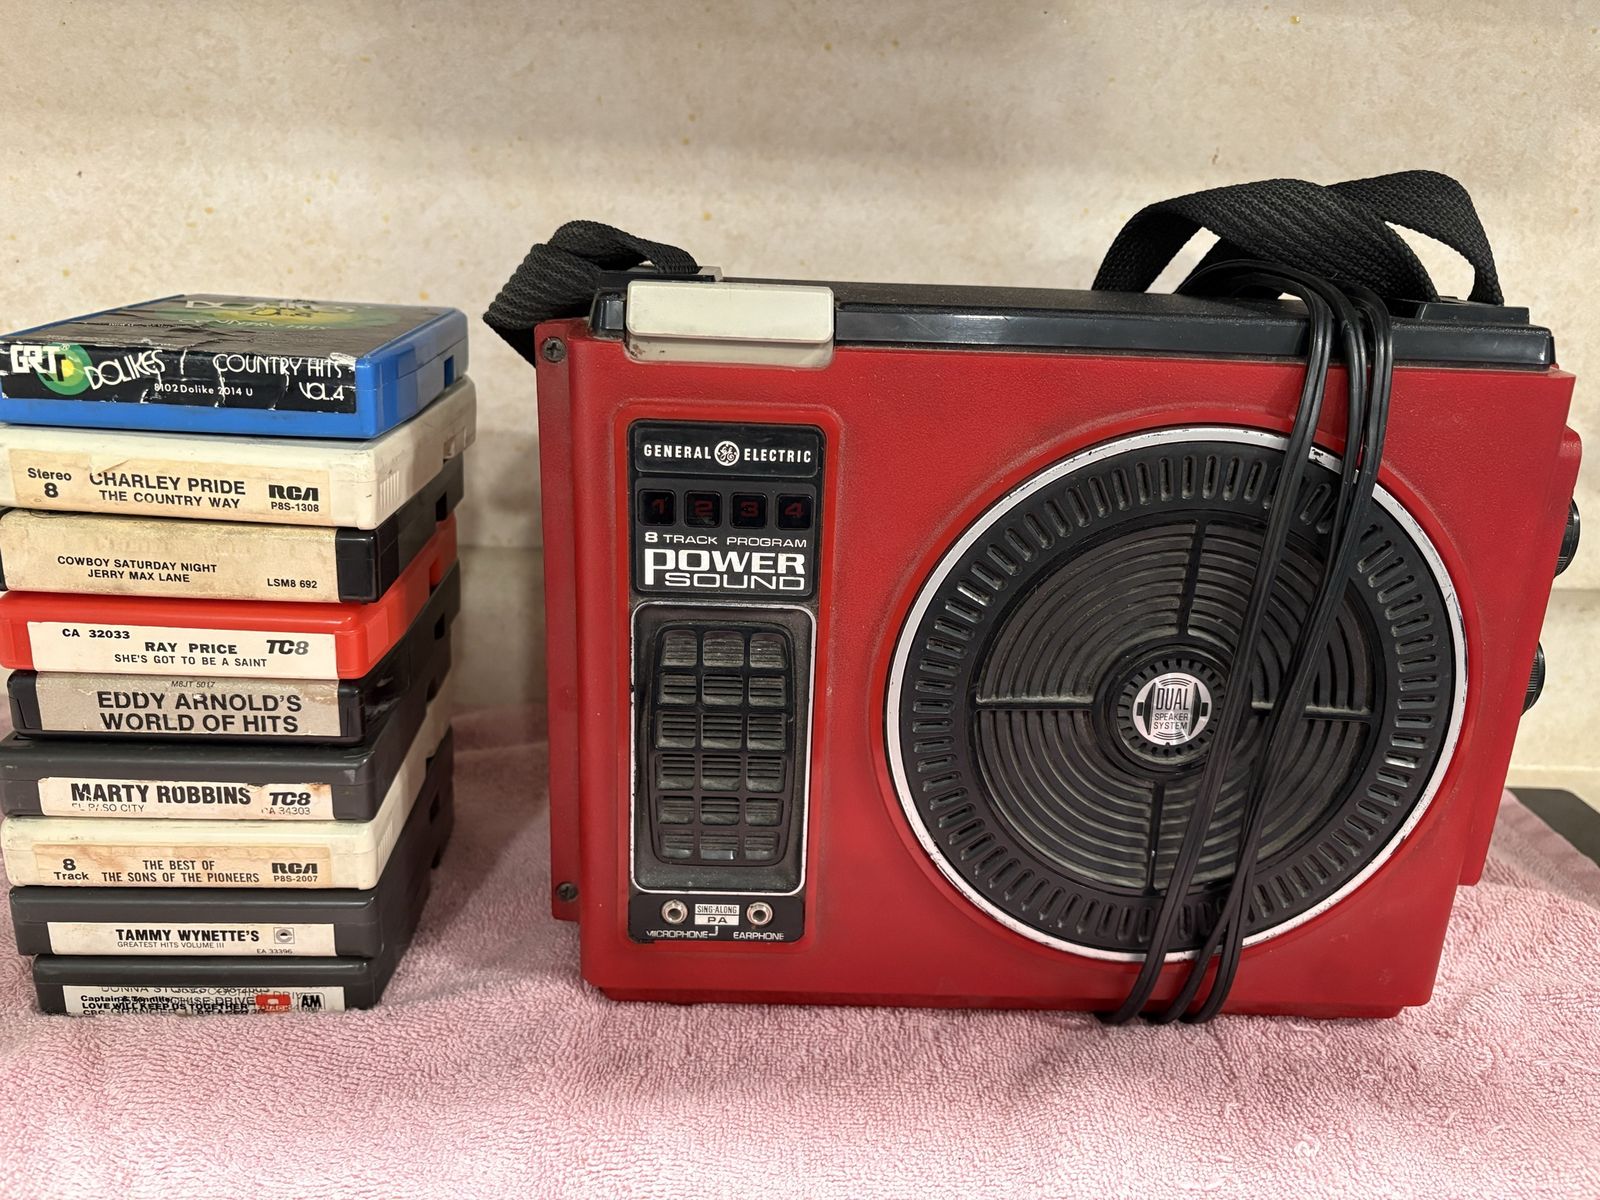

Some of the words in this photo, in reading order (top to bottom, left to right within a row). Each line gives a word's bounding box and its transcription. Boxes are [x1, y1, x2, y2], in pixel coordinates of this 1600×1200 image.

[10, 344, 61, 374] GRT
[84, 349, 166, 390] DOLIKES
[213, 354, 301, 375] COUNTRY
[307, 357, 342, 378] HITS
[217, 386, 242, 396] 2014
[246, 388, 253, 396] U
[644, 444, 711, 459] GENERAL
[744, 448, 811, 463] ELECTRIC
[27, 467, 72, 482] Stereo
[44, 482, 59, 498] 8
[89, 472, 182, 490] CHARLEY
[187, 478, 246, 496] PRIDE
[100, 490, 128, 502] THE
[133, 492, 202, 507] COUNTRY
[208, 497, 240, 509] WAY
[268, 484, 319, 502] RCA
[270, 501, 320, 513] P8S-1308
[652, 499, 664, 514] 1
[694, 500, 713, 517] 2
[740, 501, 758, 517] 3
[785, 502, 805, 517] 4
[645, 531, 658, 543] 8
[663, 534, 718, 545] TRACK
[727, 536, 807, 548] PROGRAM
[57, 555, 110, 568] COWBOY
[114, 559, 177, 571] SATURDAY
[180, 562, 217, 573] NIGHT
[645, 549, 805, 586] POWER
[87, 568, 125, 579] JERRY
[129, 570, 155, 581] MAX
[159, 572, 190, 583] LANE
[664, 572, 805, 590] SOUND
[267, 578, 296, 588] LSM8
[299, 579, 318, 589] 692
[62, 628, 81, 638] CA
[88, 629, 131, 639] 32033
[144, 641, 177, 652] RAY
[188, 643, 238, 655] PRICE
[266, 639, 309, 655] TC8
[114, 653, 148, 664] SHE'S
[153, 655, 176, 665] GOT
[181, 656, 196, 666] TO
[201, 657, 217, 666] BE
[222, 657, 230, 666] A
[234, 658, 267, 668] SAINT
[97, 691, 165, 710] EDDY
[175, 693, 302, 712] ARNOLD'S
[1156, 688, 1189, 710] DUAL
[100, 713, 195, 731] WORLD
[202, 714, 235, 731] OF
[243, 715, 299, 733] HITS
[1154, 712, 1189, 721] SPEAKER
[1153, 721, 1188, 730] SYSTEM
[70, 783, 149, 803] MARTY
[157, 785, 251, 805] ROBBINS
[269, 792, 311, 806] TC8
[120, 804, 145, 813] CITY
[279, 807, 311, 816] 34303
[63, 858, 77, 871] 8
[142, 860, 165, 871] THE
[169, 860, 196, 871] BEST
[201, 860, 216, 871] OF
[271, 862, 318, 874] RCA
[53, 871, 89, 881] Track
[101, 872, 124, 882] THE
[127, 872, 158, 882] SONS
[162, 872, 176, 882] OF
[182, 872, 203, 882] THE
[207, 872, 260, 883] PIONEERS
[273, 875, 318, 883] P8S-2007
[697, 905, 737, 914] SING-ALONG
[707, 916, 728, 924] PA
[116, 929, 172, 941] TAMMY
[177, 929, 260, 942] WYNETTE'S
[646, 930, 708, 939] MICROPHONE
[733, 931, 784, 941] EARPHONE
[117, 941, 158, 949] GREATEST
[160, 941, 179, 949] HITS
[180, 941, 214, 949] VOLUME
[216, 941, 225, 949] III
[81, 995, 120, 1003] Captain
